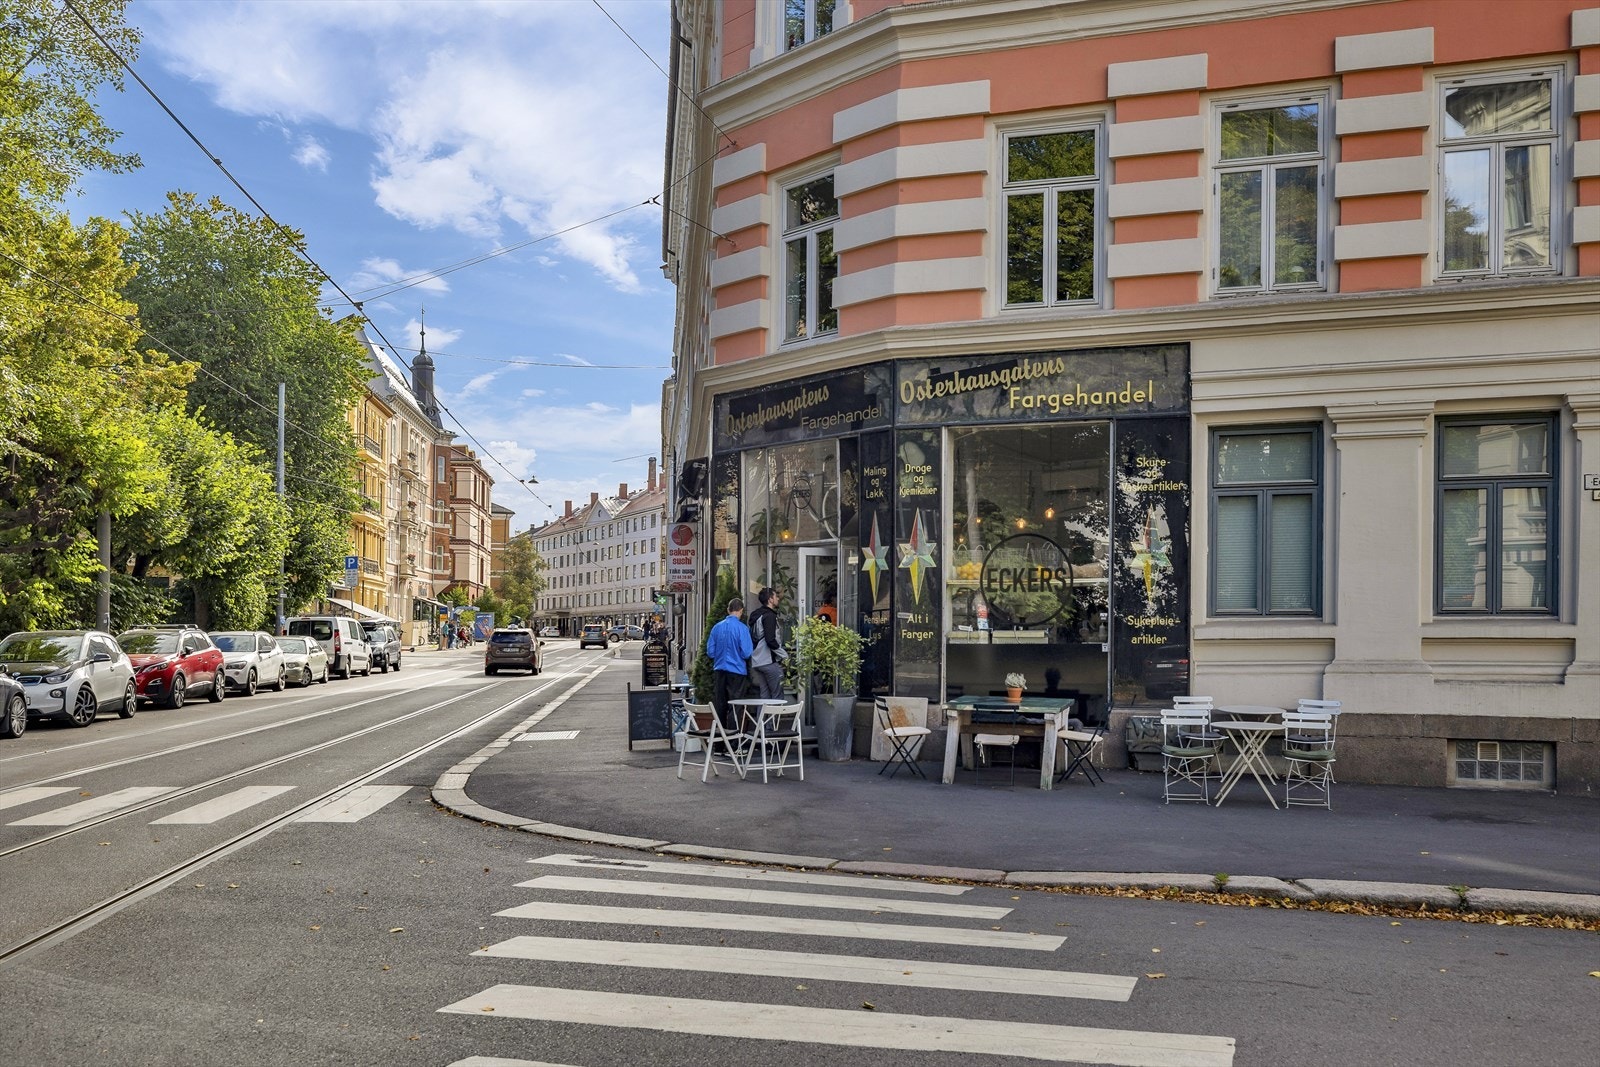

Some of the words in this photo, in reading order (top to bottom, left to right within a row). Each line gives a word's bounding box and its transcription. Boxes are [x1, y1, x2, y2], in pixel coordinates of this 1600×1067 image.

[901, 357, 1065, 404] Osterhausgatens
[1009, 380, 1153, 413] Fargehandel
[725, 385, 830, 437] Osterhausgatens
[801, 403, 882, 430] Fargehandel
[1136, 456, 1171, 467] Skure-
[863, 466, 887, 477] Maling
[905, 463, 932, 475] Droge
[1146, 470, 1158, 479] og
[870, 478, 880, 487] og
[913, 475, 924, 485] og
[899, 485, 938, 498] Kjemikalier
[1122, 481, 1183, 492] Vaskeartikler
[865, 489, 884, 499] Lakk
[669, 548, 696, 556] sakura
[672, 557, 692, 565] sushi
[985, 567, 1067, 593] ECKERS
[907, 613, 922, 624] Alt
[901, 629, 934, 641] Farger
[1131, 634, 1167, 644] artikler
